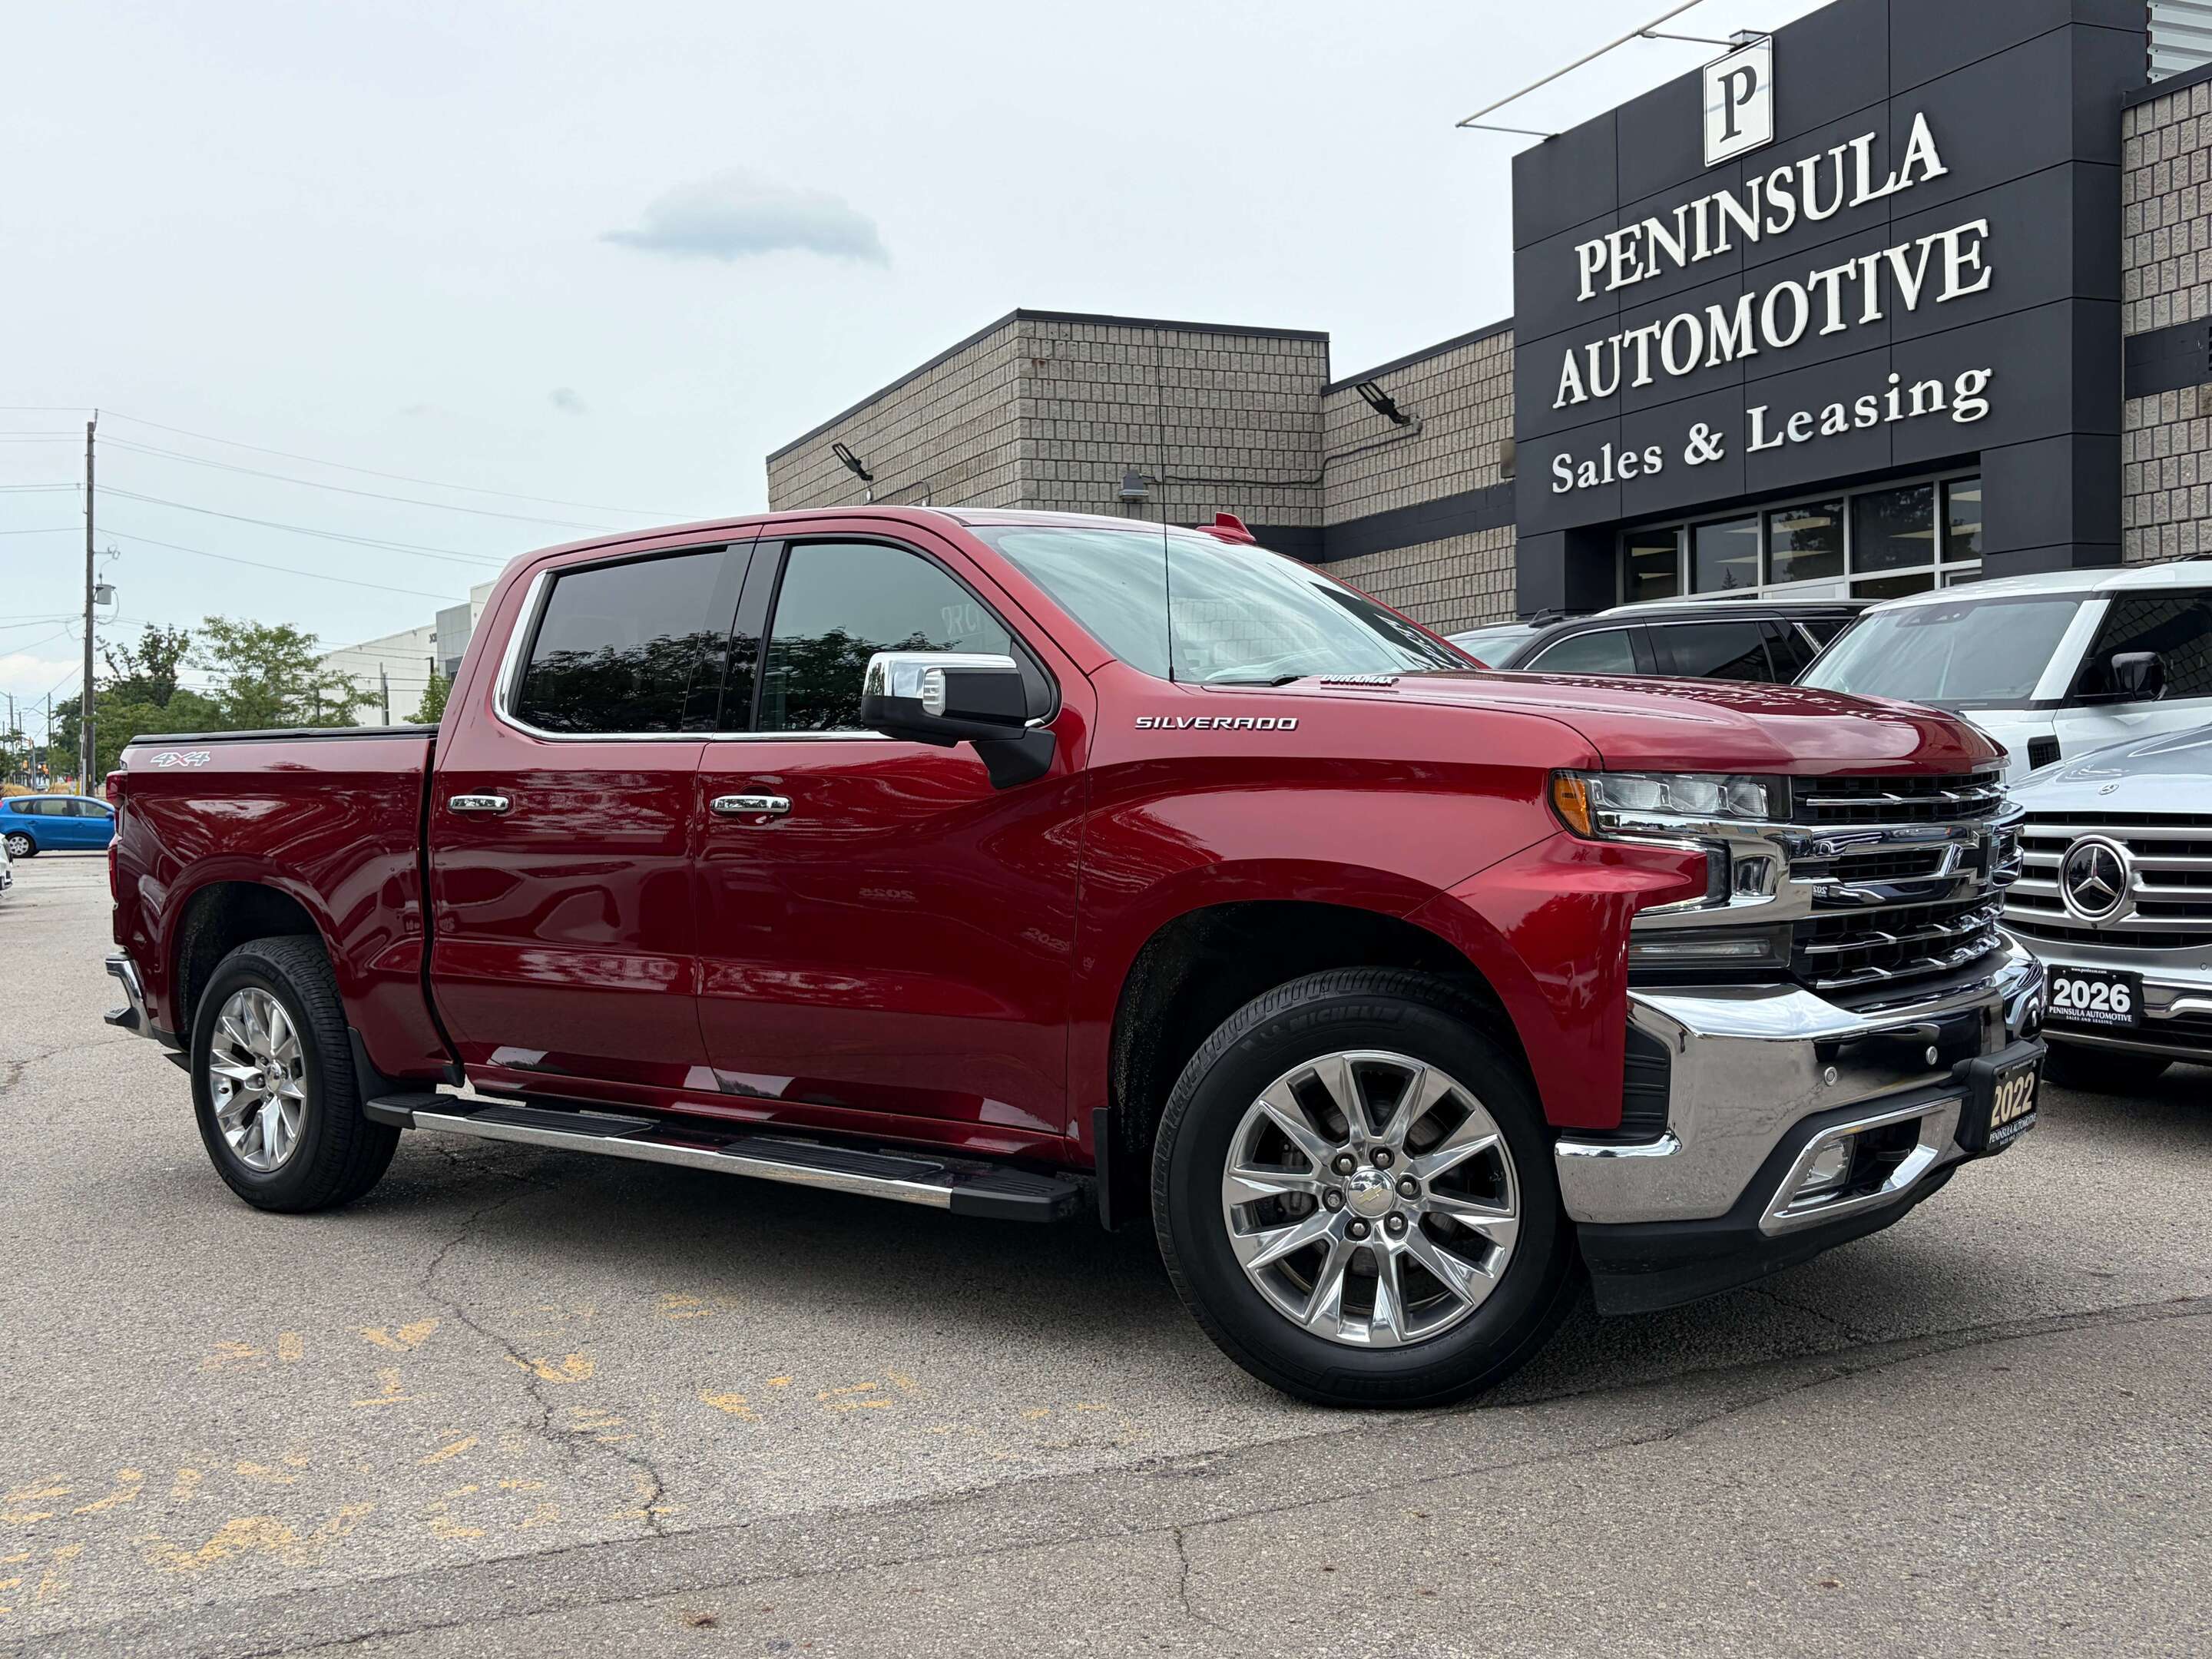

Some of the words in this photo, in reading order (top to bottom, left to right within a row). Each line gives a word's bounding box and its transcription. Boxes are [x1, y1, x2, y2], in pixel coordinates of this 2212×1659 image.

[1718, 66, 1757, 142] P
[1575, 112, 1947, 301] PENINSULA
[1553, 219, 1992, 409] AUTOMOTIVE
[1552, 442, 1662, 492] Sales
[1684, 423, 1724, 465] &
[1747, 368, 1992, 452] Leasing
[1320, 674, 1394, 686] DURAMAX
[1135, 717, 1299, 730] SILVERADO
[2048, 1006, 2085, 1017] PENINSULA
[2086, 1010, 2133, 1022] AUTOMOTIVE
[2053, 979, 2131, 1013] 2026
[1991, 1071, 2035, 1128] 2022
